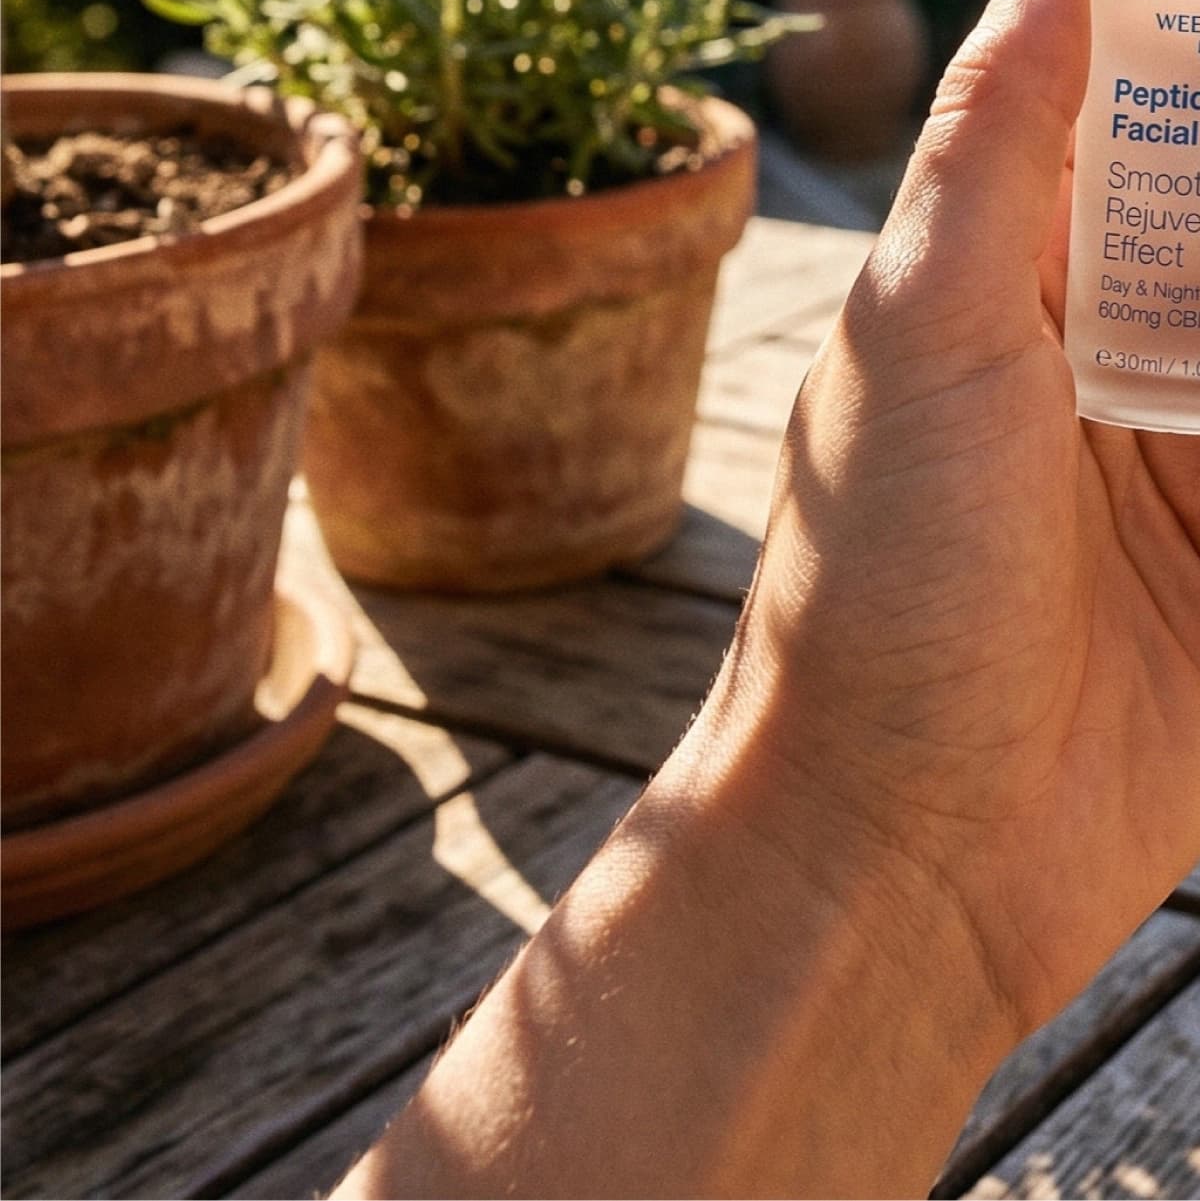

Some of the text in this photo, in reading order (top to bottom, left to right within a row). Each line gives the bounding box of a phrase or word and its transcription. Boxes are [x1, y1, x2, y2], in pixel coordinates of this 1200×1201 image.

[1112, 114, 1198, 146] Facial
[1103, 232, 1184, 268] Effect
[1101, 275, 1200, 304] Day & Night
[1098, 300, 1161, 329] 600mg
